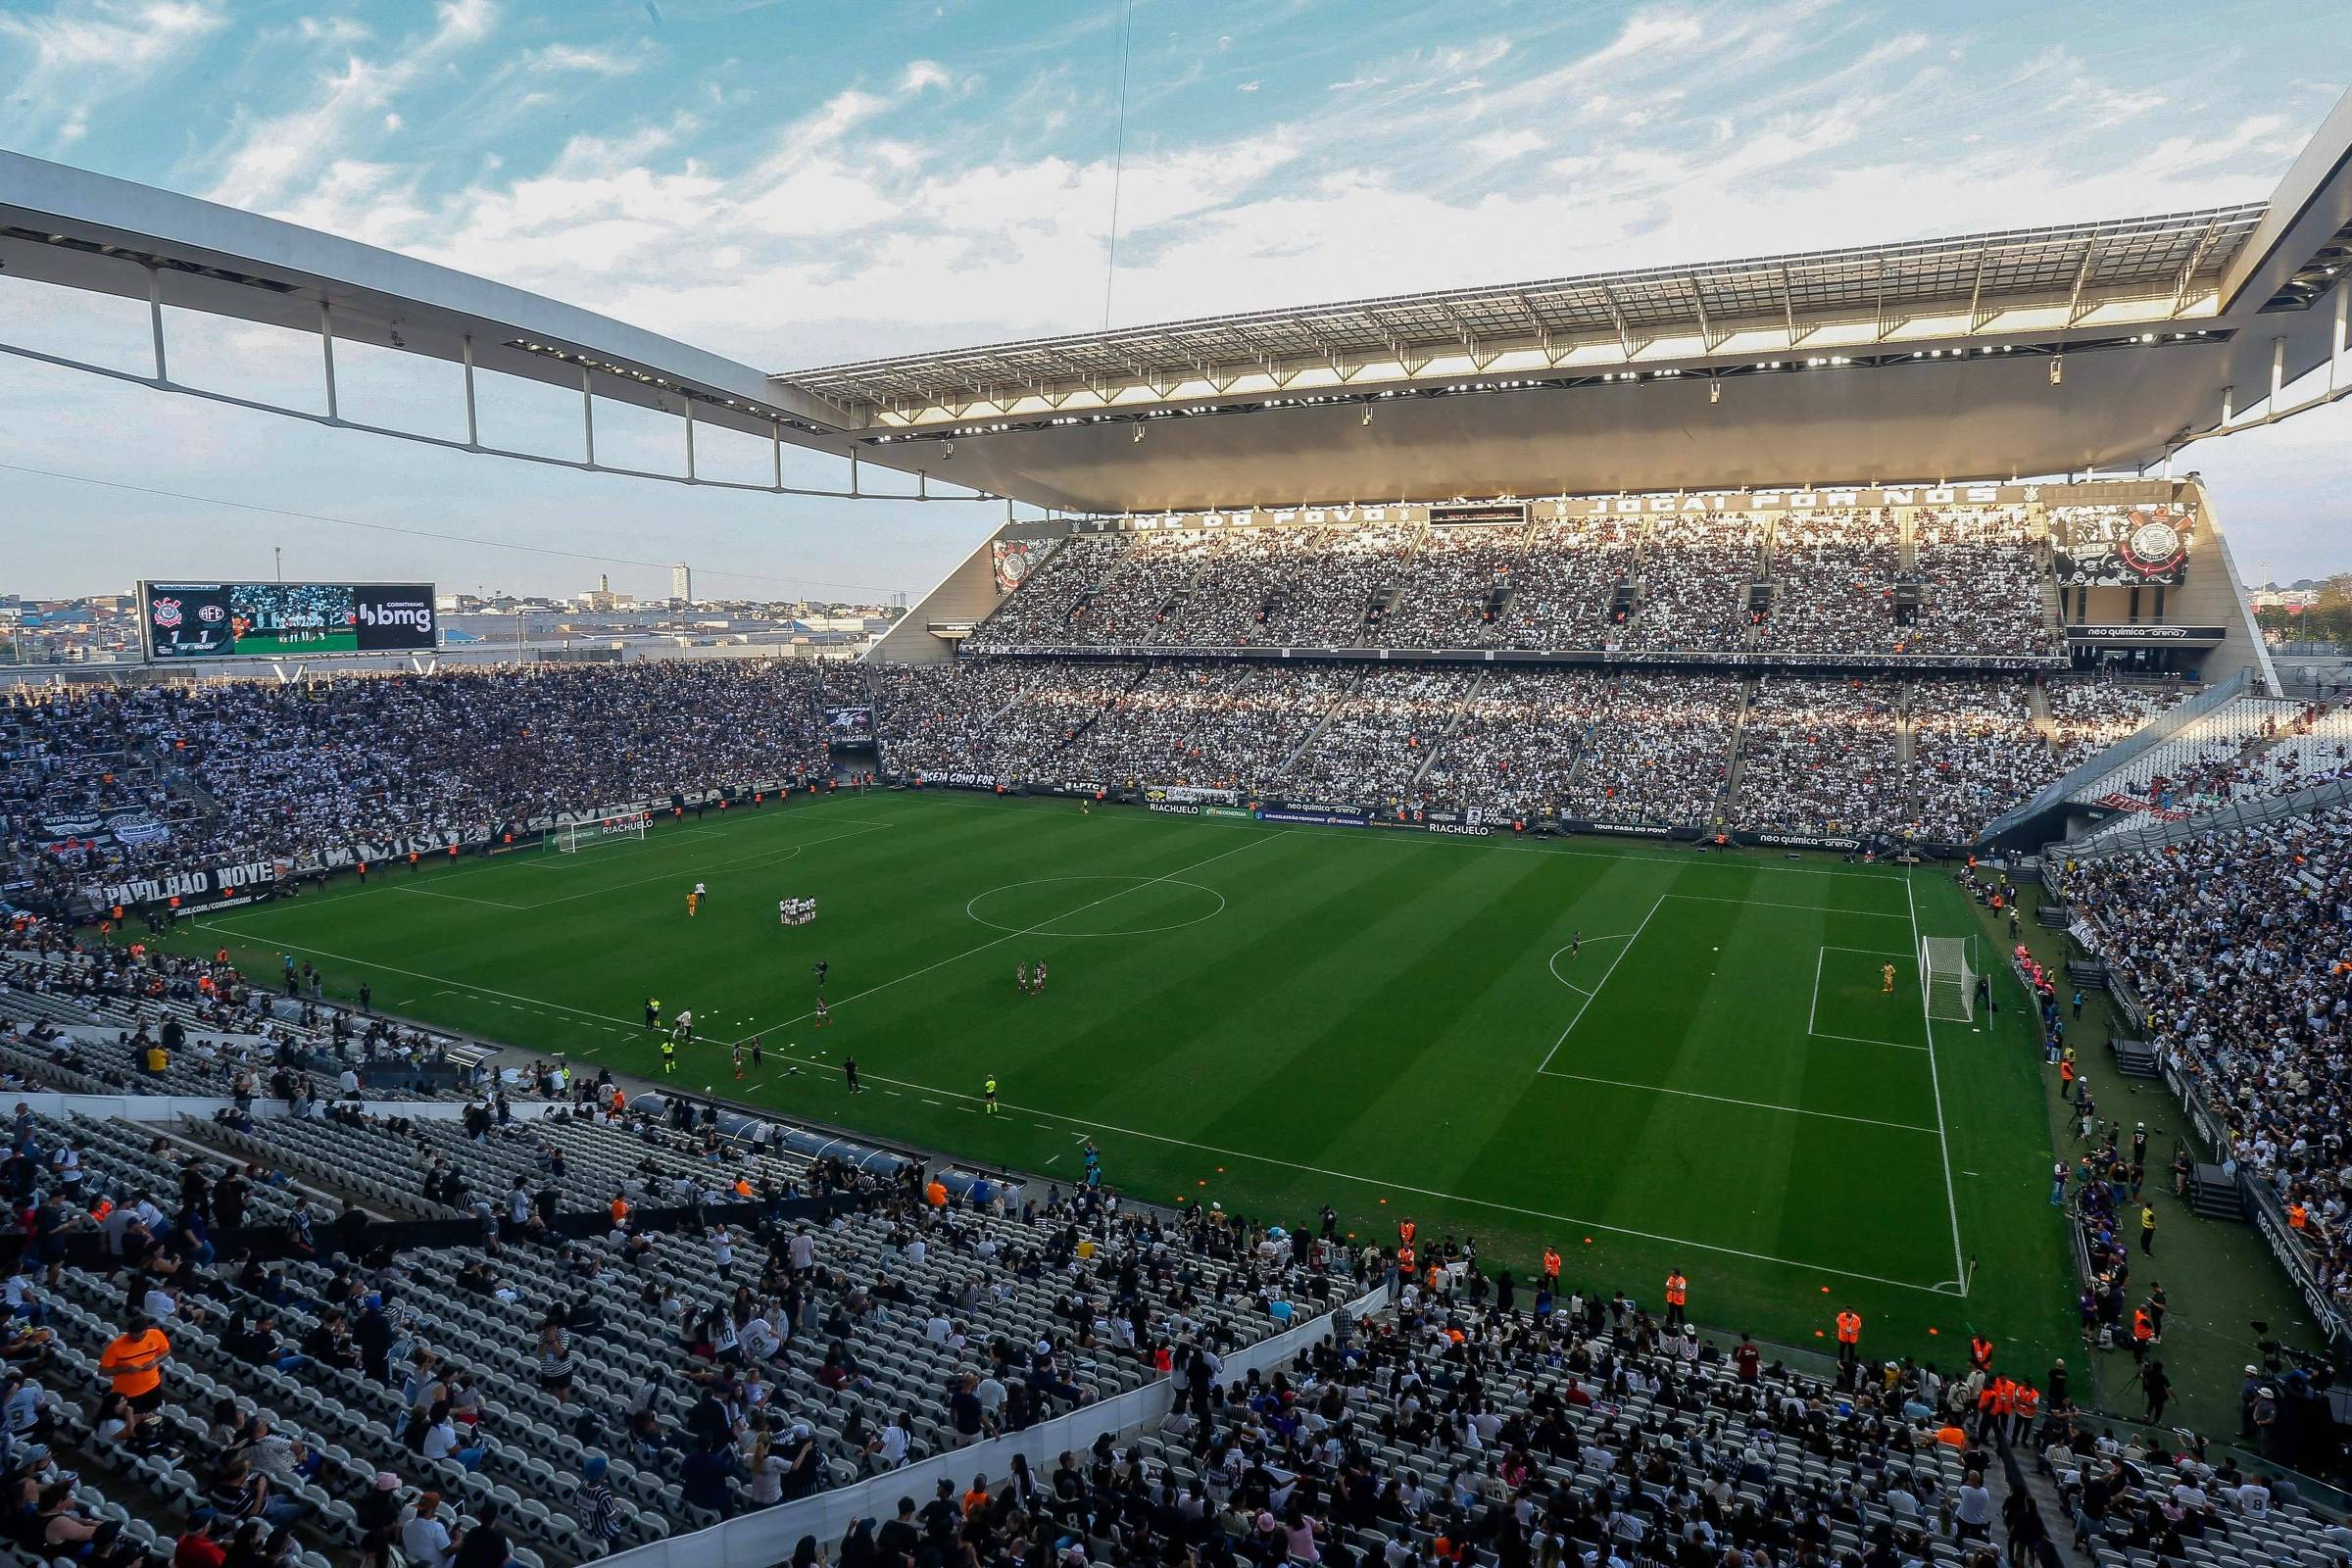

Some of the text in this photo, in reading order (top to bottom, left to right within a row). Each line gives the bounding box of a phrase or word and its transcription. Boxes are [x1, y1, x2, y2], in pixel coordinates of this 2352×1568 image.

[1589, 496, 1726, 514] JOGAI
[1751, 489, 1856, 509] POR
[1092, 508, 1385, 531] TIME DO POVO
[200, 607, 222, 620] AFE
[377, 604, 431, 632] bmg
[171, 630, 209, 644] 1 1
[2108, 627, 2145, 637] química
[950, 772, 974, 784] COMO
[977, 774, 995, 785] FOR
[1150, 804, 1199, 814] RIACHUELO
[1302, 803, 1330, 811] química
[603, 819, 654, 836] RIACHUELO
[1429, 823, 1489, 836] RIACHUELO
[1781, 835, 1818, 846] química
[217, 861, 273, 889] NOVE
[2257, 1210, 2329, 1334] neo química arena
